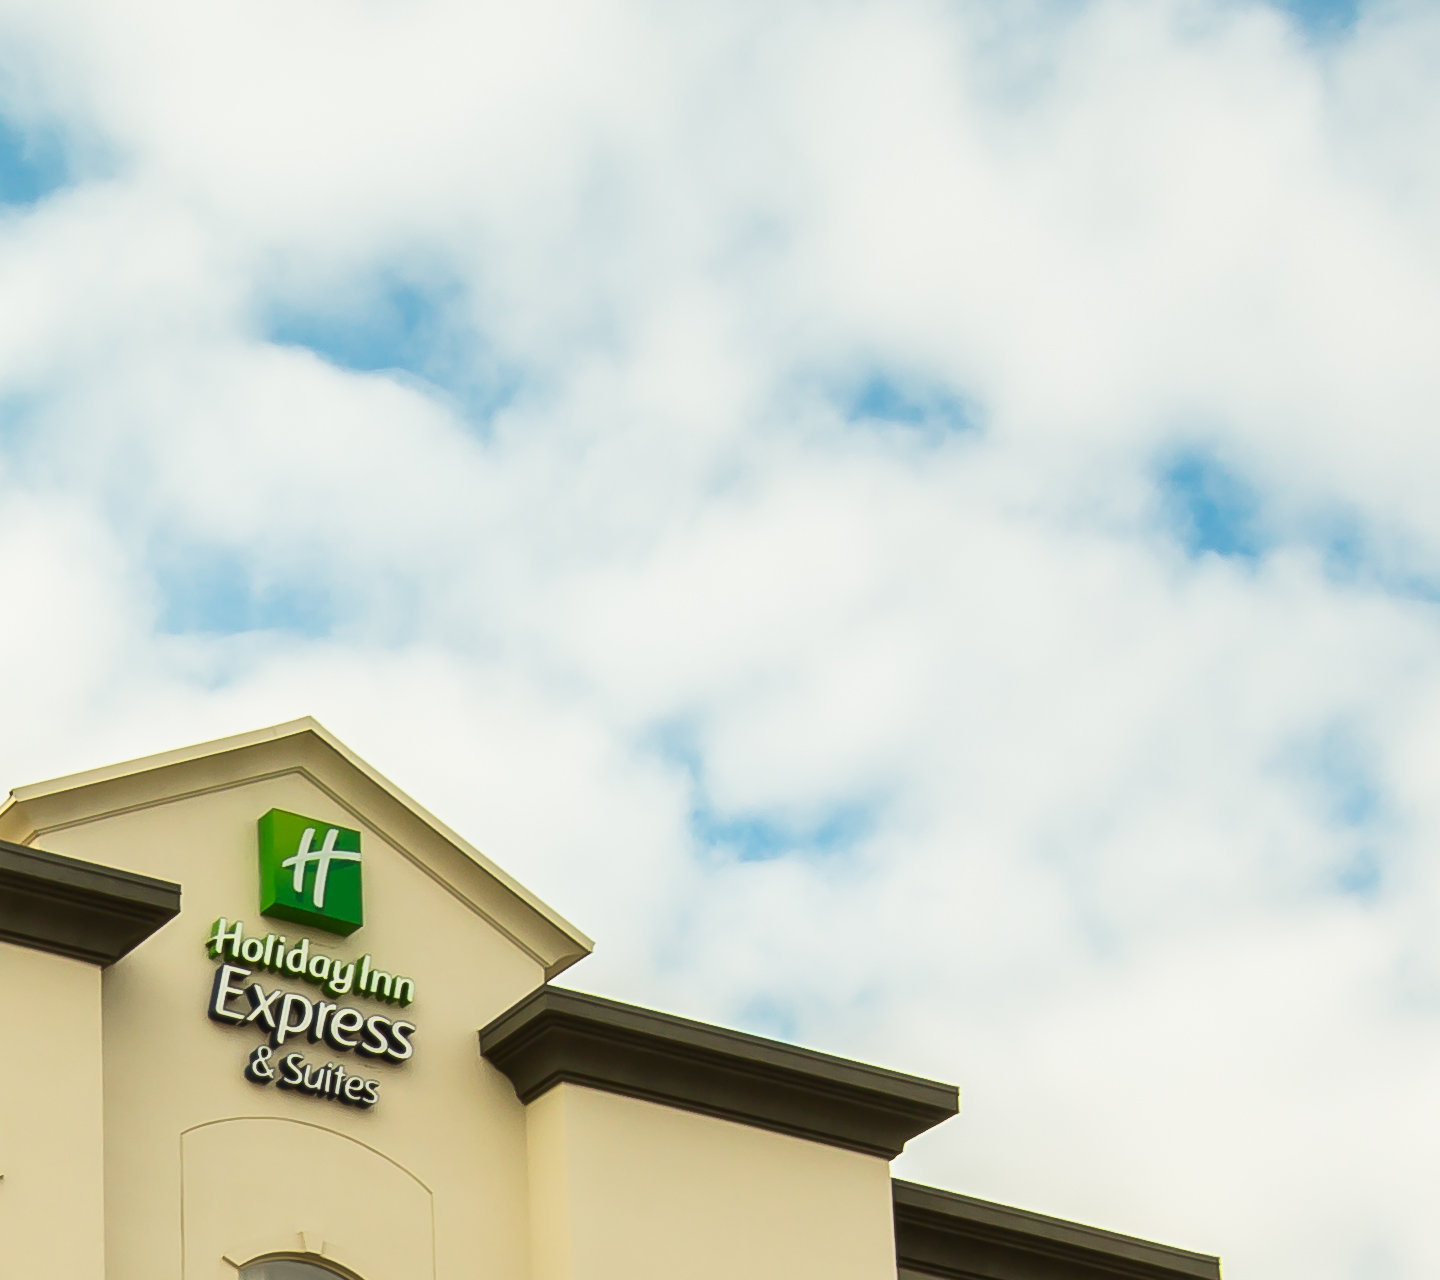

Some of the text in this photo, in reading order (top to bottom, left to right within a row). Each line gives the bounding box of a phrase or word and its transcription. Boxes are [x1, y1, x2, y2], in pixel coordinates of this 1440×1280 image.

[206, 917, 415, 1004] Holiday Inn
[213, 964, 416, 1060] Express
[249, 1045, 380, 1105] & Suites
